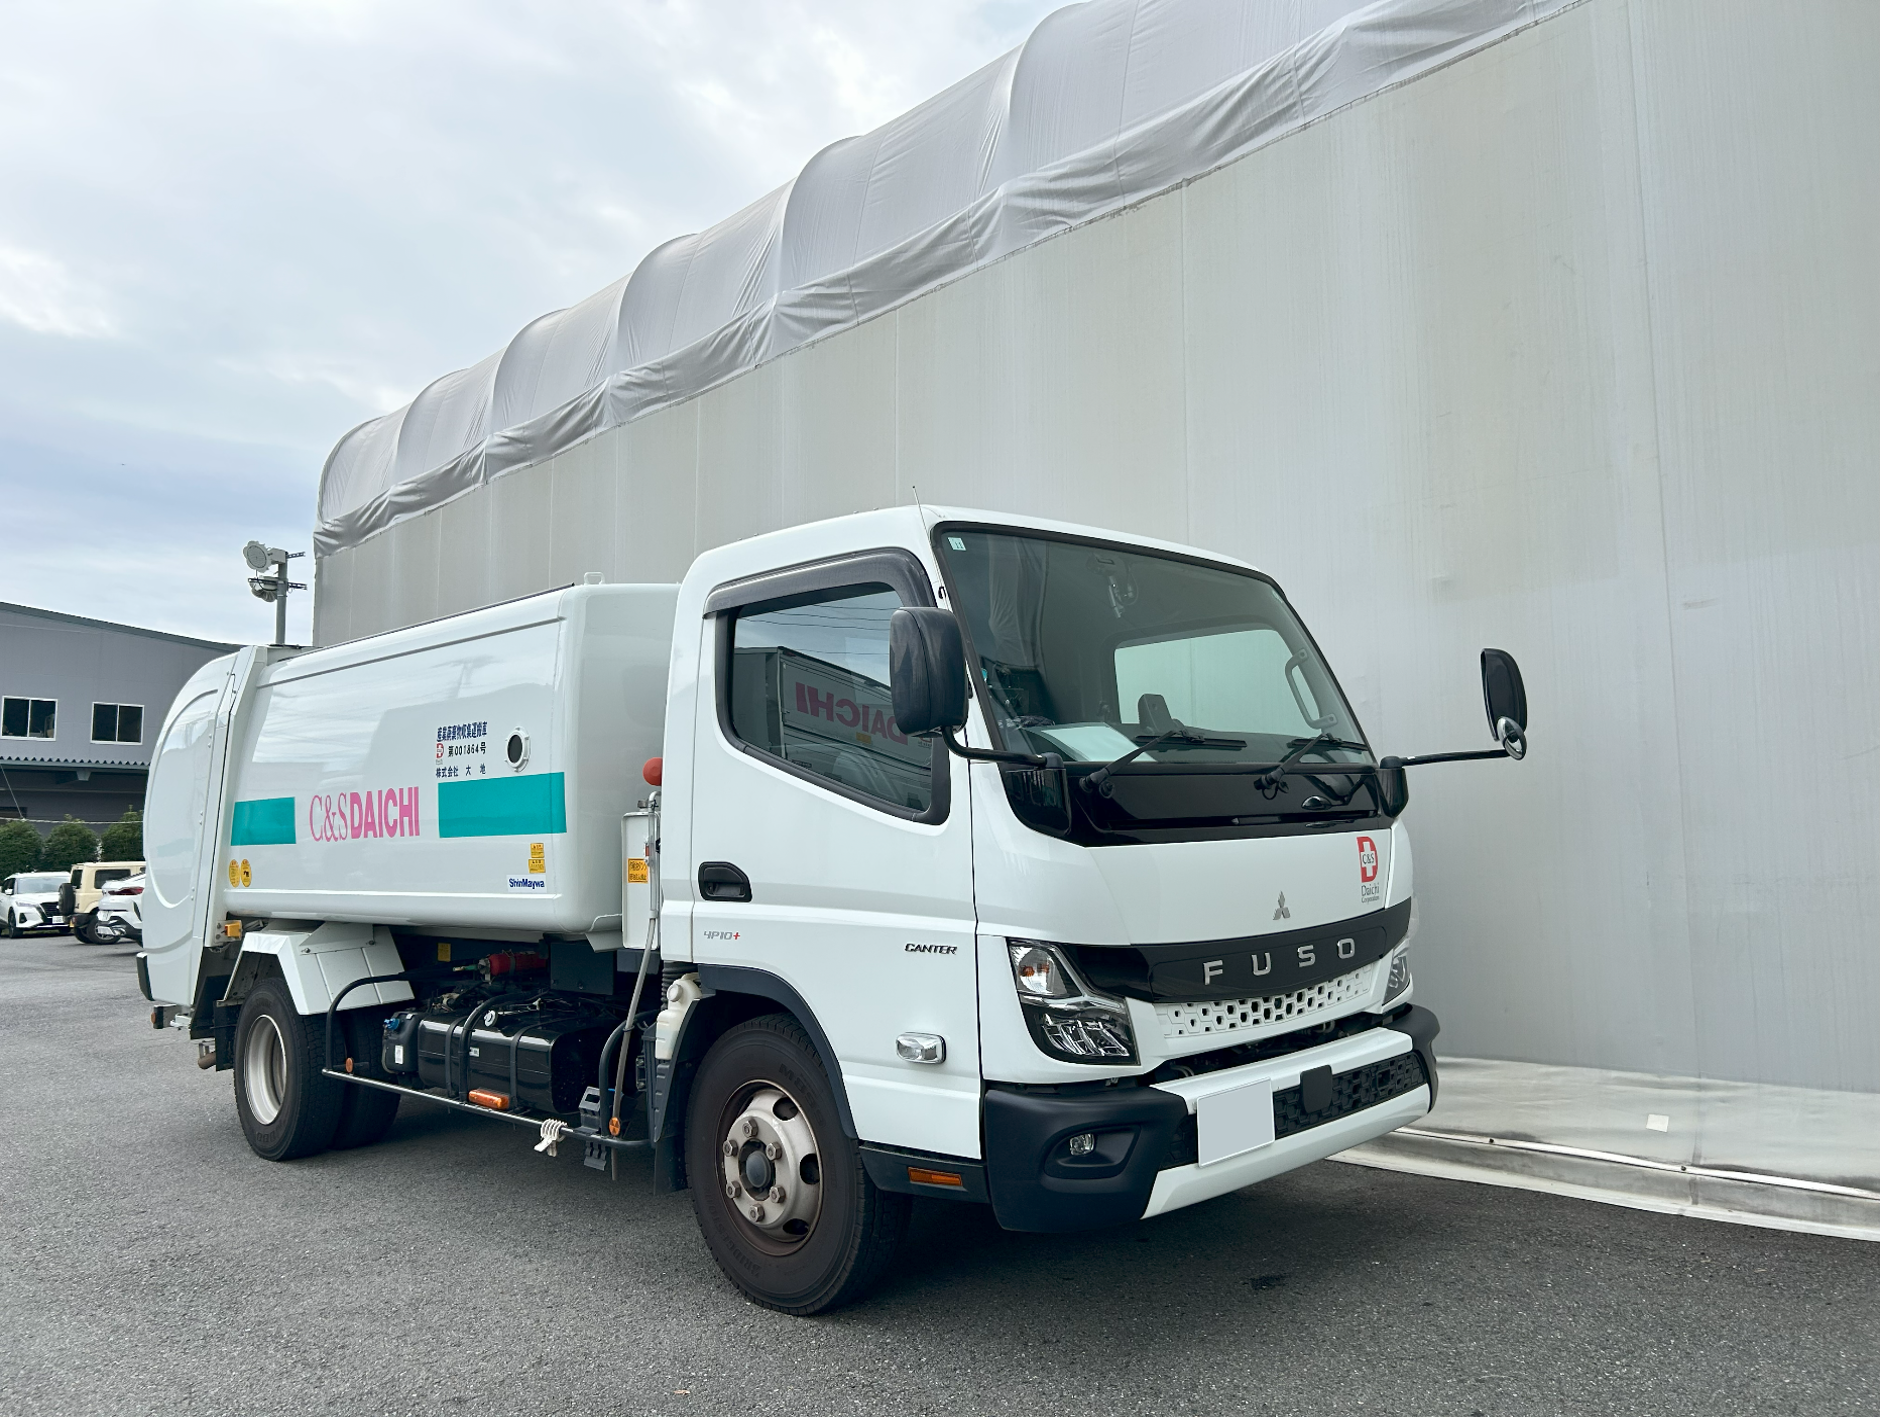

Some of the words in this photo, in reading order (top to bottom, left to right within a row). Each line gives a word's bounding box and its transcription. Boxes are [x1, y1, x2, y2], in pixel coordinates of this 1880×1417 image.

[447, 741, 487, 758] 第001864号
[435, 765, 459, 778] 株式会社
[1362, 853, 1375, 865] C&S
[508, 878, 545, 890] ShinMaywa
[1361, 883, 1380, 897] Daichi
[904, 943, 958, 955] CANTER
[1203, 938, 1355, 985] FUSO
